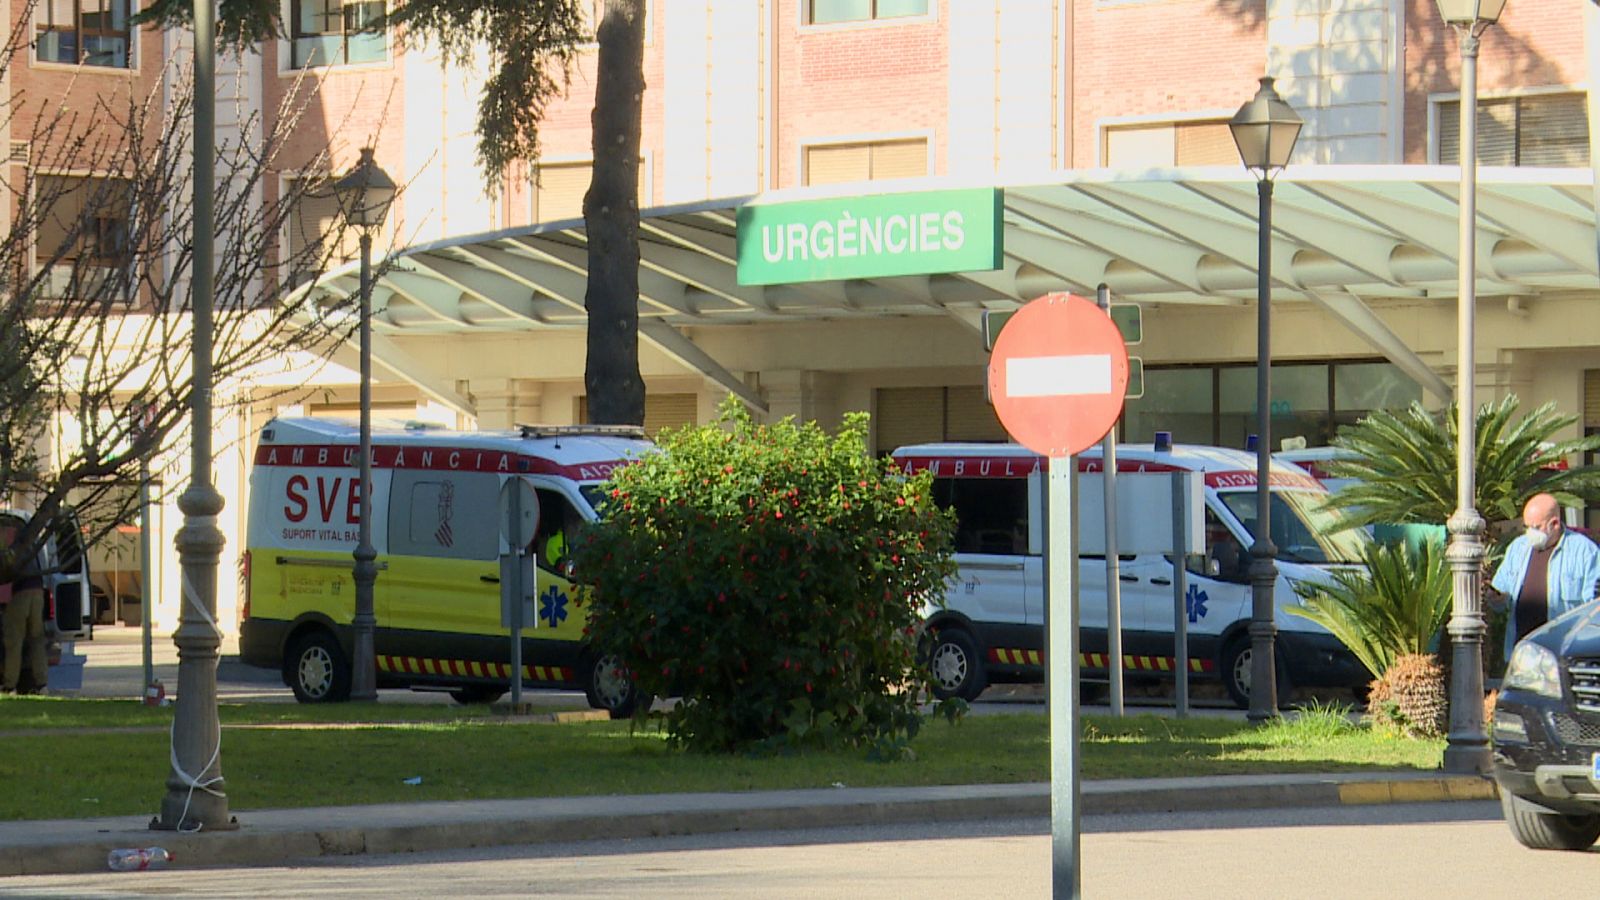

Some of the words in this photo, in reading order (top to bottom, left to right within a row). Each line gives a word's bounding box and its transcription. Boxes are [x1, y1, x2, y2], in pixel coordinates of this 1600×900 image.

[761, 210, 966, 262] URGÈNCIES
[282, 528, 316, 540] SUPORT
[319, 530, 343, 541] VITAL
